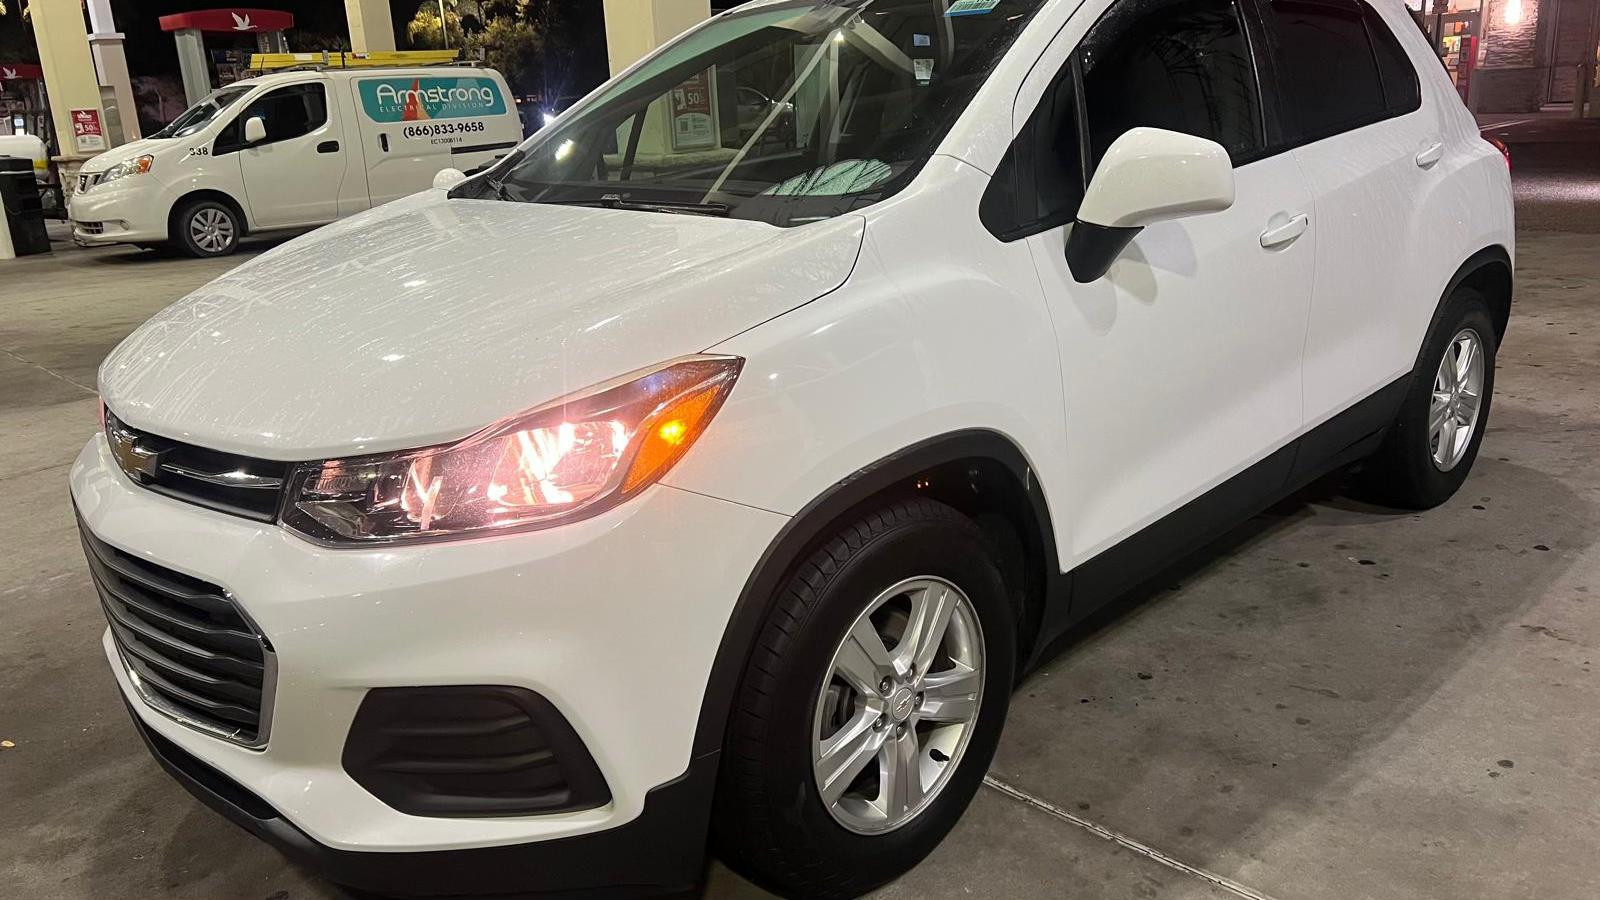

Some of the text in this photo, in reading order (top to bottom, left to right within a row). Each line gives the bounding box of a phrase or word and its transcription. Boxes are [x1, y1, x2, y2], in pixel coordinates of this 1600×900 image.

[376, 84, 494, 106] Armstrong
[442, 102, 484, 111] DIVISION
[403, 121, 485, 139] (866)833-9658
